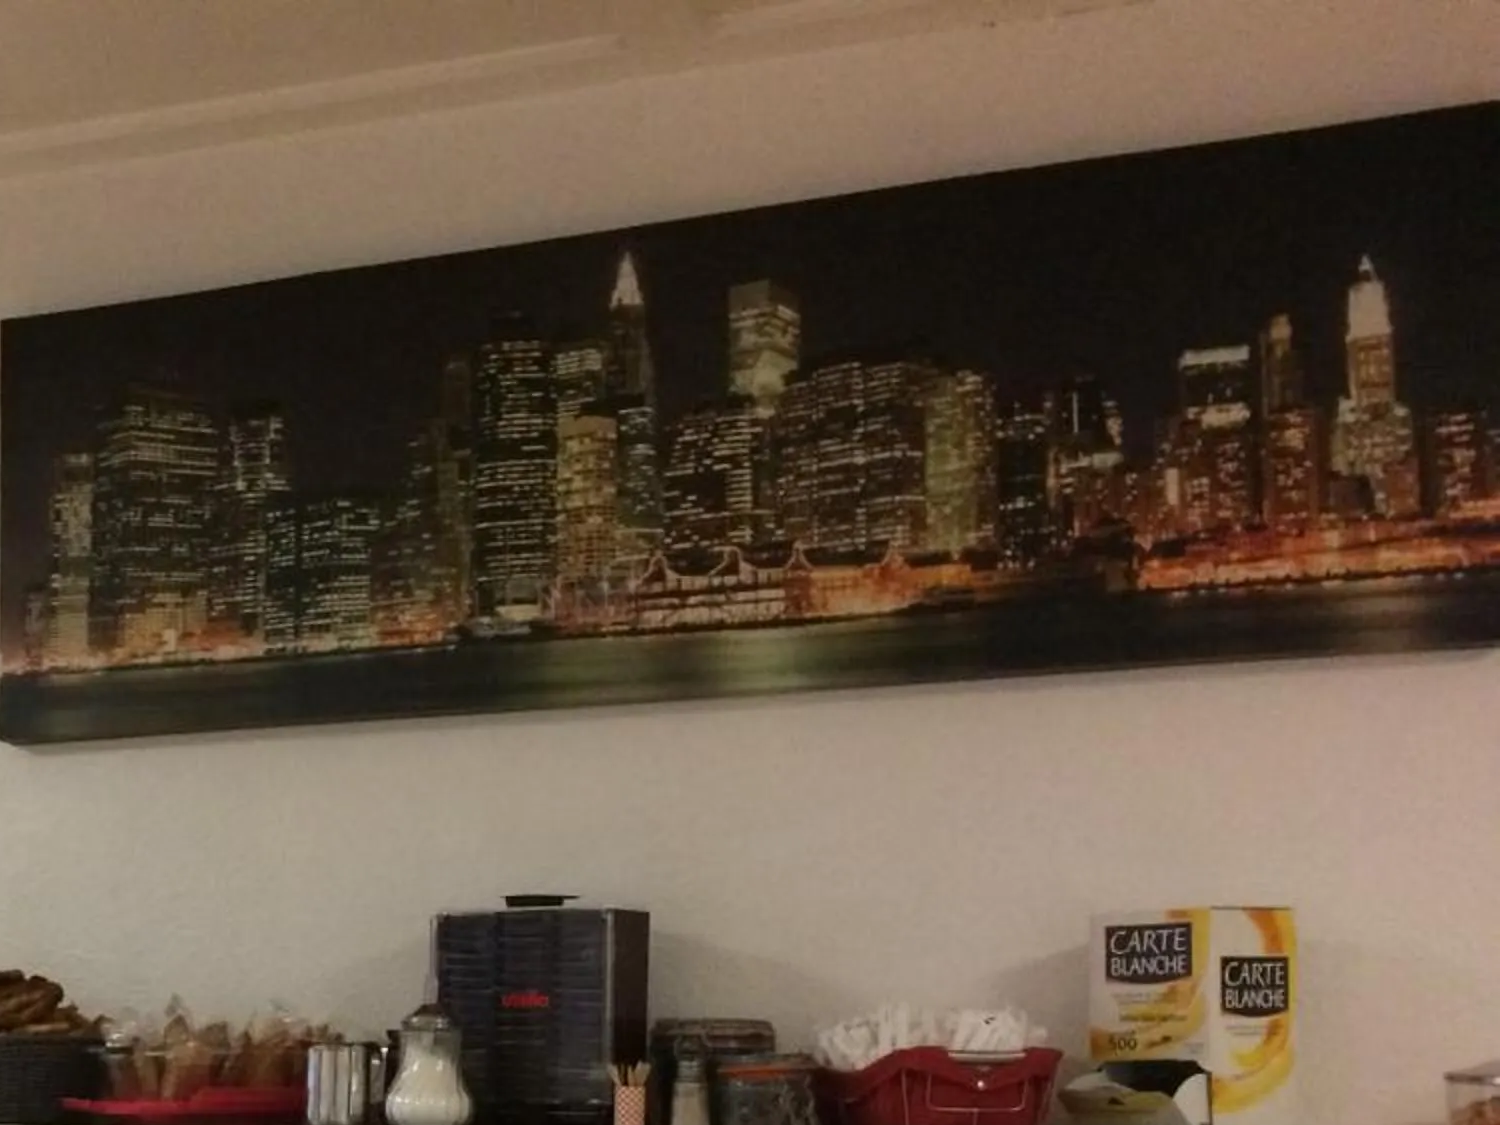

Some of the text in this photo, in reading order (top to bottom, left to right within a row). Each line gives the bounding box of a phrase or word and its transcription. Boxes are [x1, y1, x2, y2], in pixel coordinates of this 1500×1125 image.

[1110, 928, 1187, 954] CARTE
[1110, 955, 1187, 977] BLANCHE
[1225, 962, 1285, 986] CARTE
[1225, 988, 1285, 1008] BLANCHE
